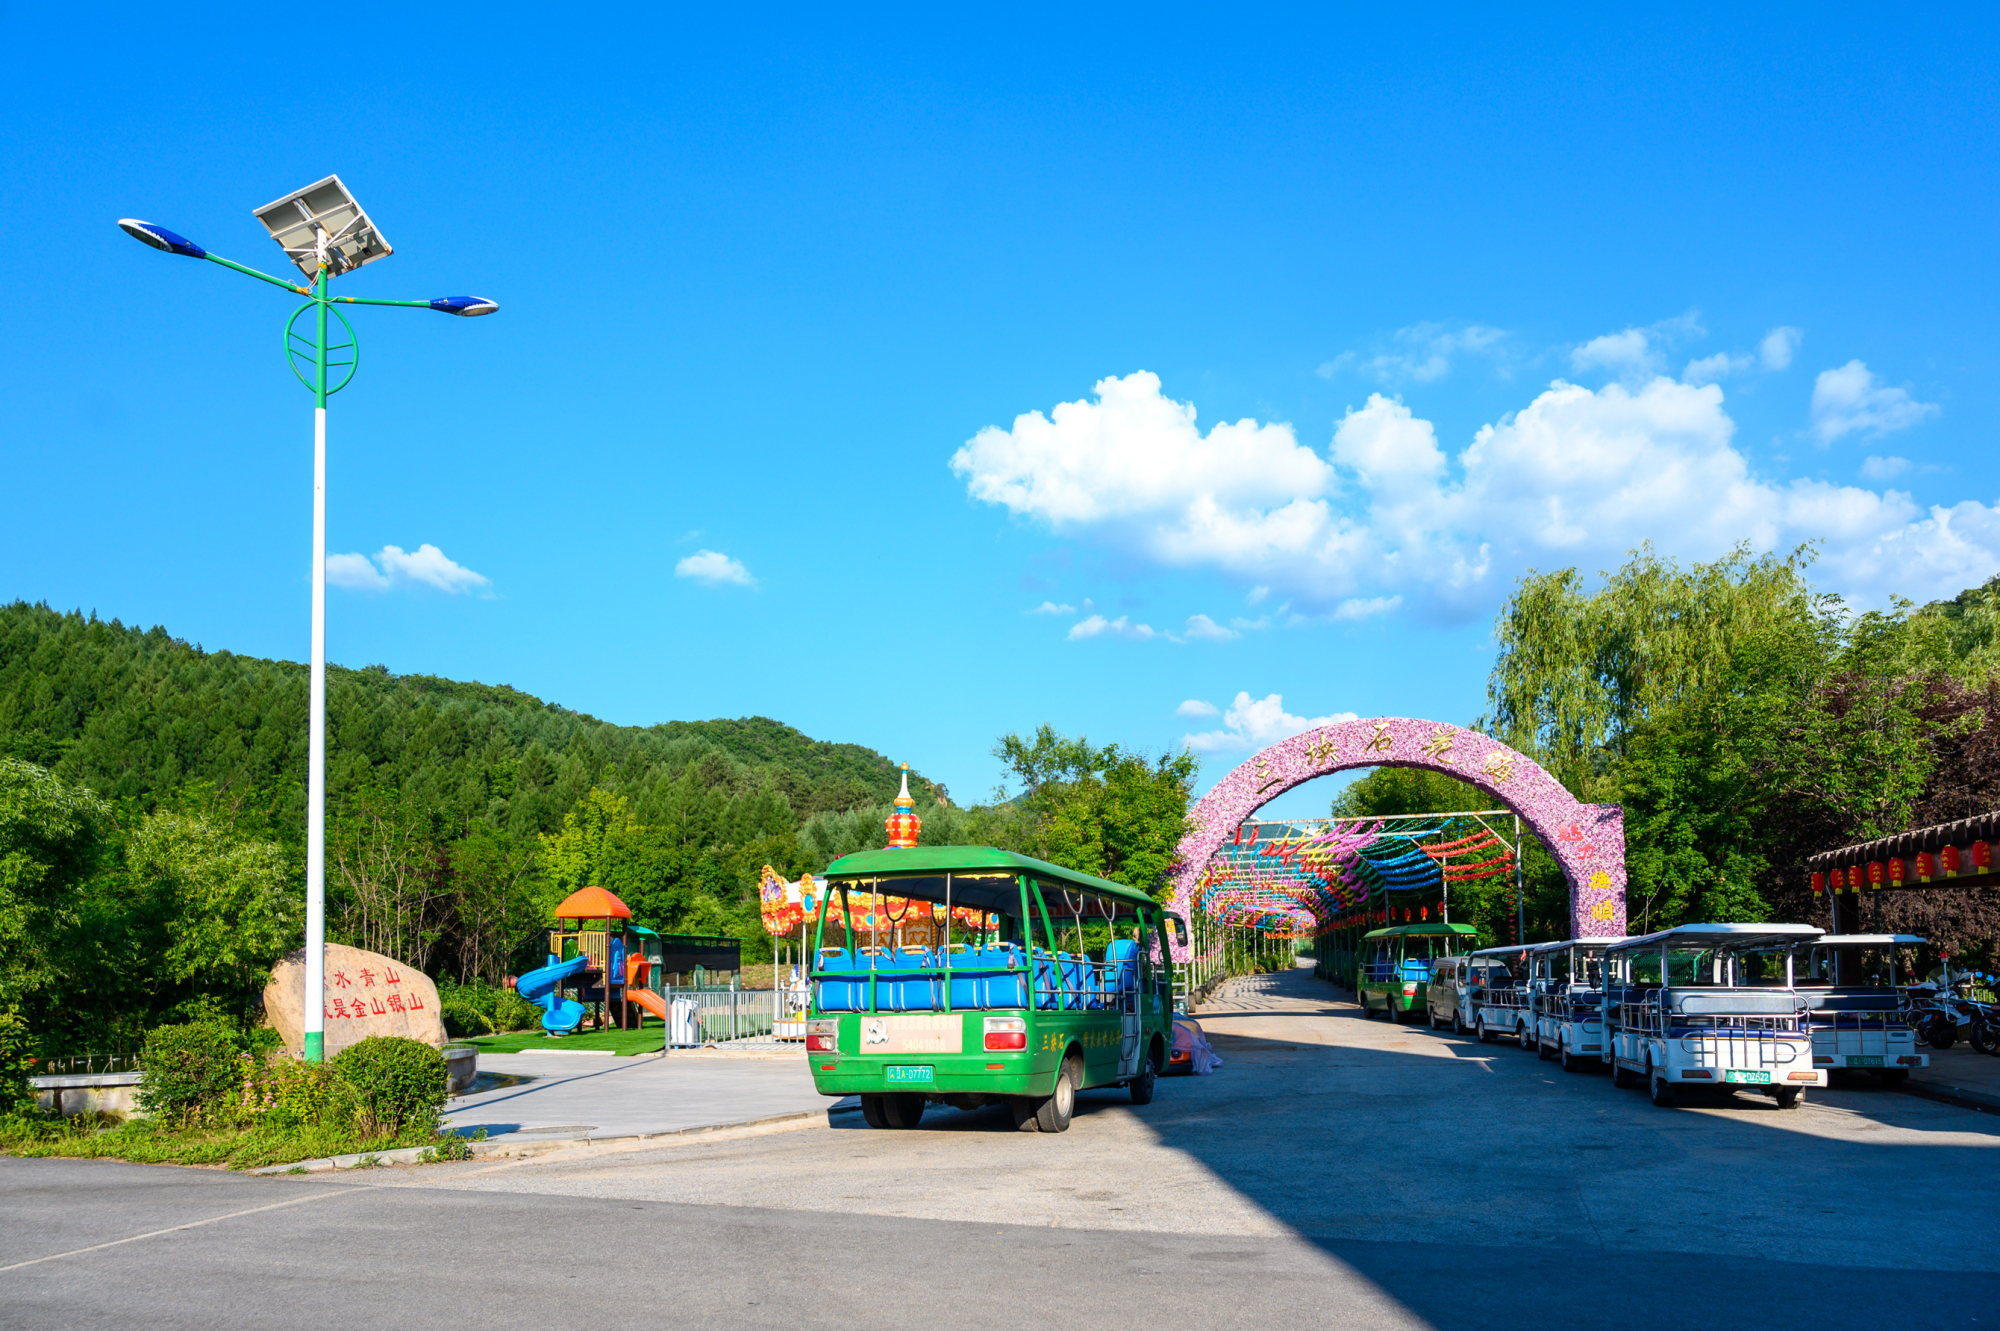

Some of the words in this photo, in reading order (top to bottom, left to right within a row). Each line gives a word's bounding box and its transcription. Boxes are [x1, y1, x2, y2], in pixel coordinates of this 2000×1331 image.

[1557, 823, 1595, 860] 魅力
[323, 966, 401, 990] 水青山
[902, 1038, 946, 1052] 54041018
